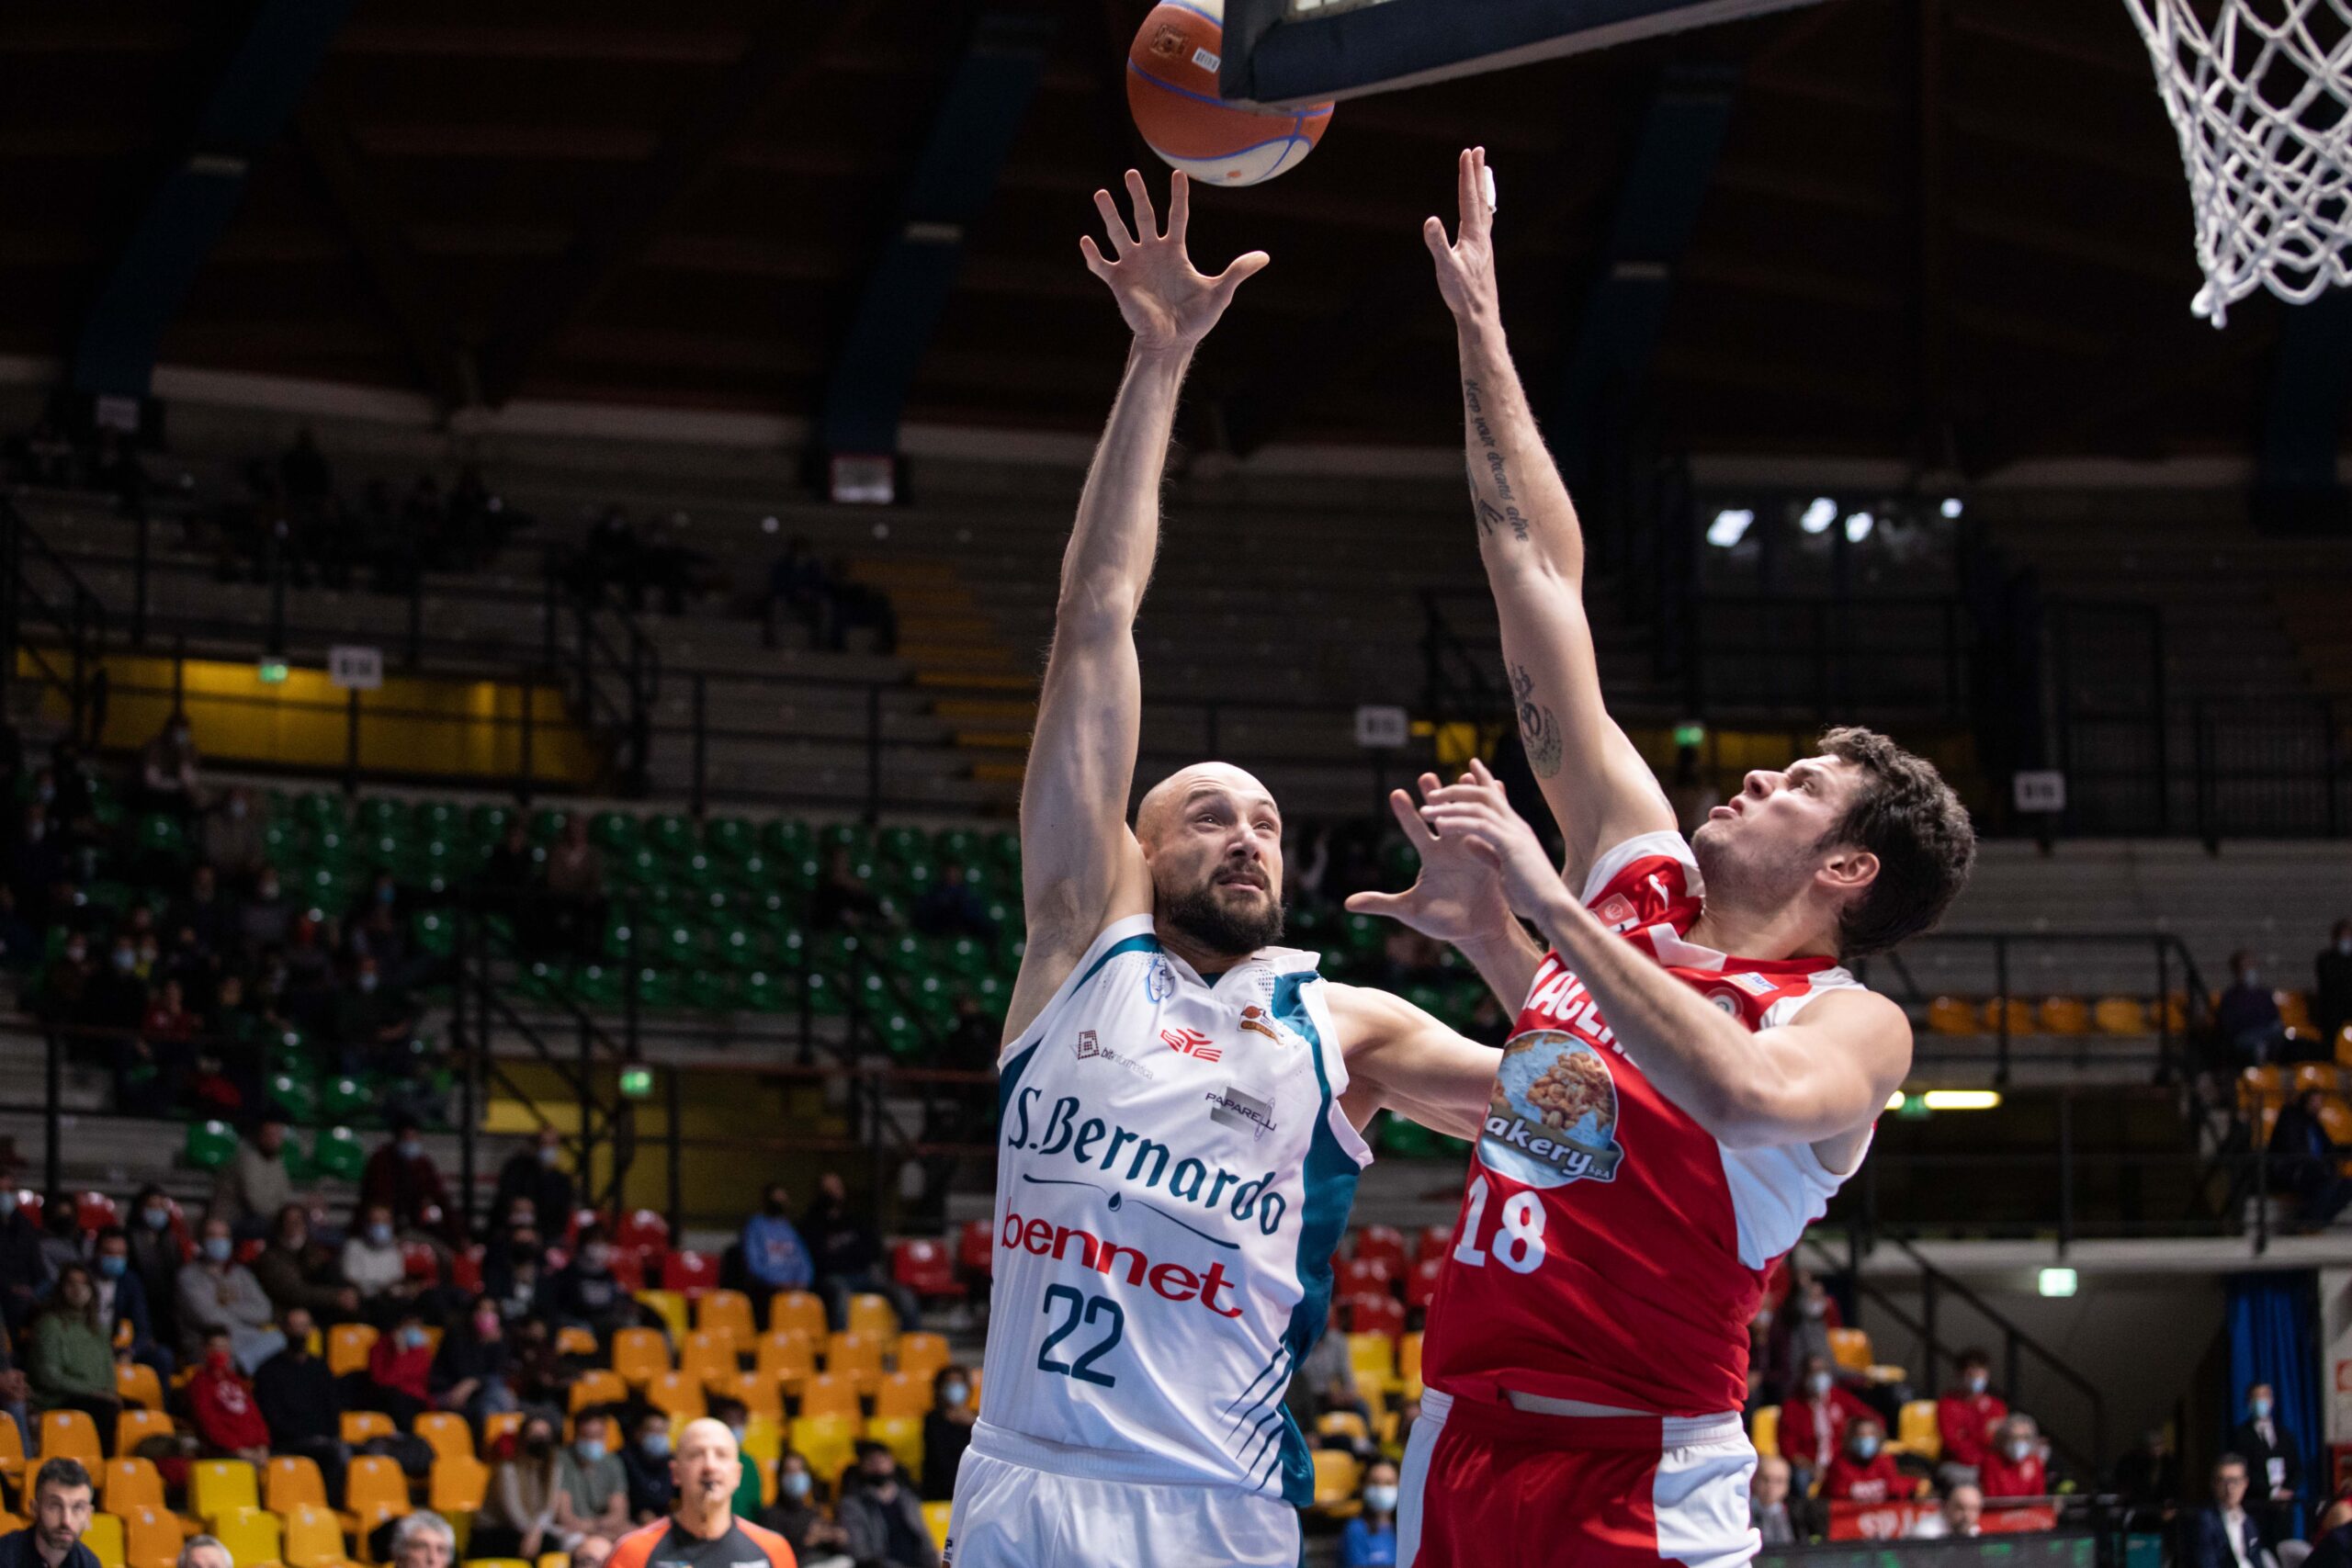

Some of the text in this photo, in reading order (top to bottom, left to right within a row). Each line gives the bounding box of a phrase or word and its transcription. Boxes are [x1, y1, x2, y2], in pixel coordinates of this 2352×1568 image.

[1506, 506, 1530, 542] alive
[1485, 1104, 1593, 1177] akery
[1001, 1196, 1243, 1318] bennet
[1453, 1174, 1547, 1275] 18
[1036, 1283, 1125, 1388] 22
